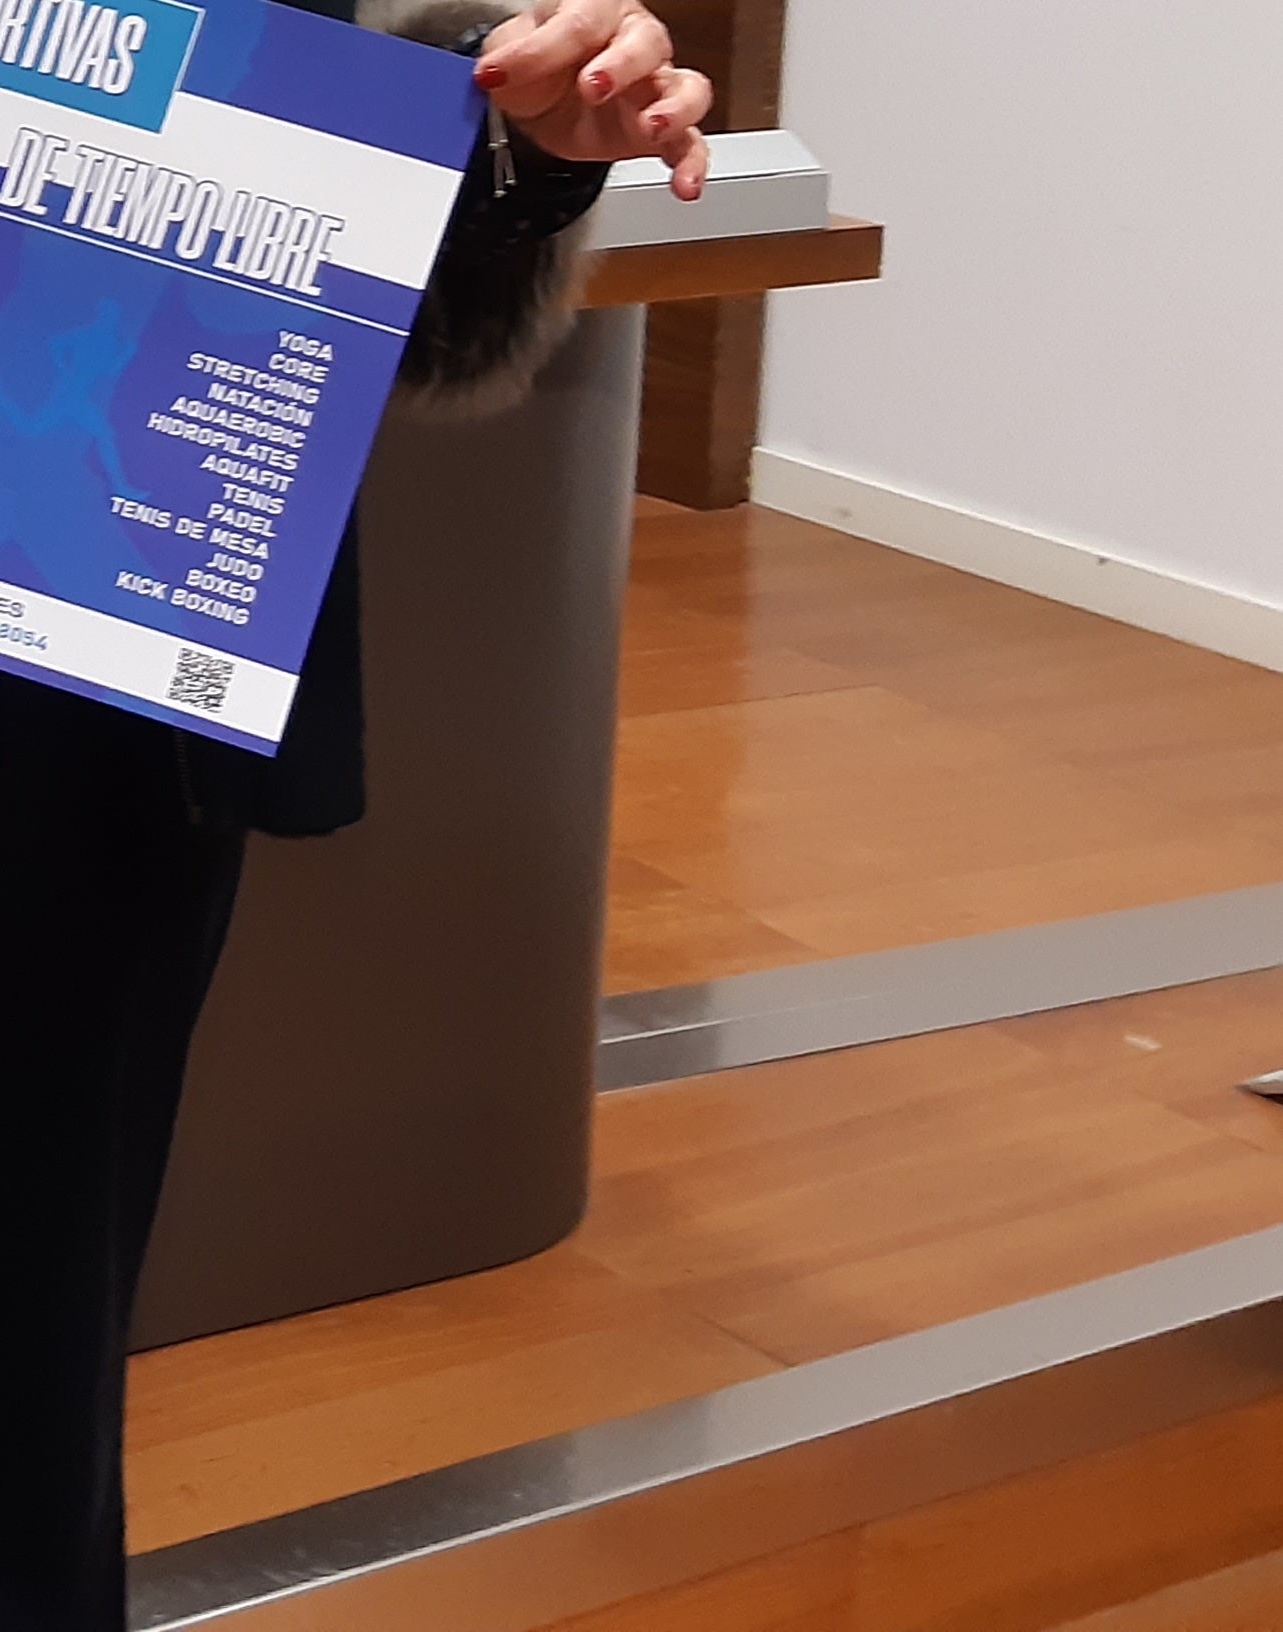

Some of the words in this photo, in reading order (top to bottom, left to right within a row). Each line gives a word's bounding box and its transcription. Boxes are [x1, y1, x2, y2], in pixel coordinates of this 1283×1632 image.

[62, 144, 223, 261] TIEMPO
[213, 189, 345, 296] LIBRE
[279, 330, 333, 362] YOGA
[186, 352, 321, 404] STRETCHING
[269, 353, 329, 383] CORE
[170, 396, 306, 449] AQUAEROBIC
[207, 382, 315, 427] NATACIÓN
[146, 412, 300, 471] HIDROPILATES
[199, 454, 294, 492] AQUAFIT
[222, 482, 285, 515] TENIS
[110, 496, 171, 529] TENIS
[175, 518, 207, 540] DE
[209, 527, 269, 560] MESA
[206, 503, 278, 538] PADEL
[185, 568, 257, 603] BOXEO
[206, 553, 264, 581] JUDO
[115, 571, 169, 600] KICK
[170, 589, 250, 625] BOXING
